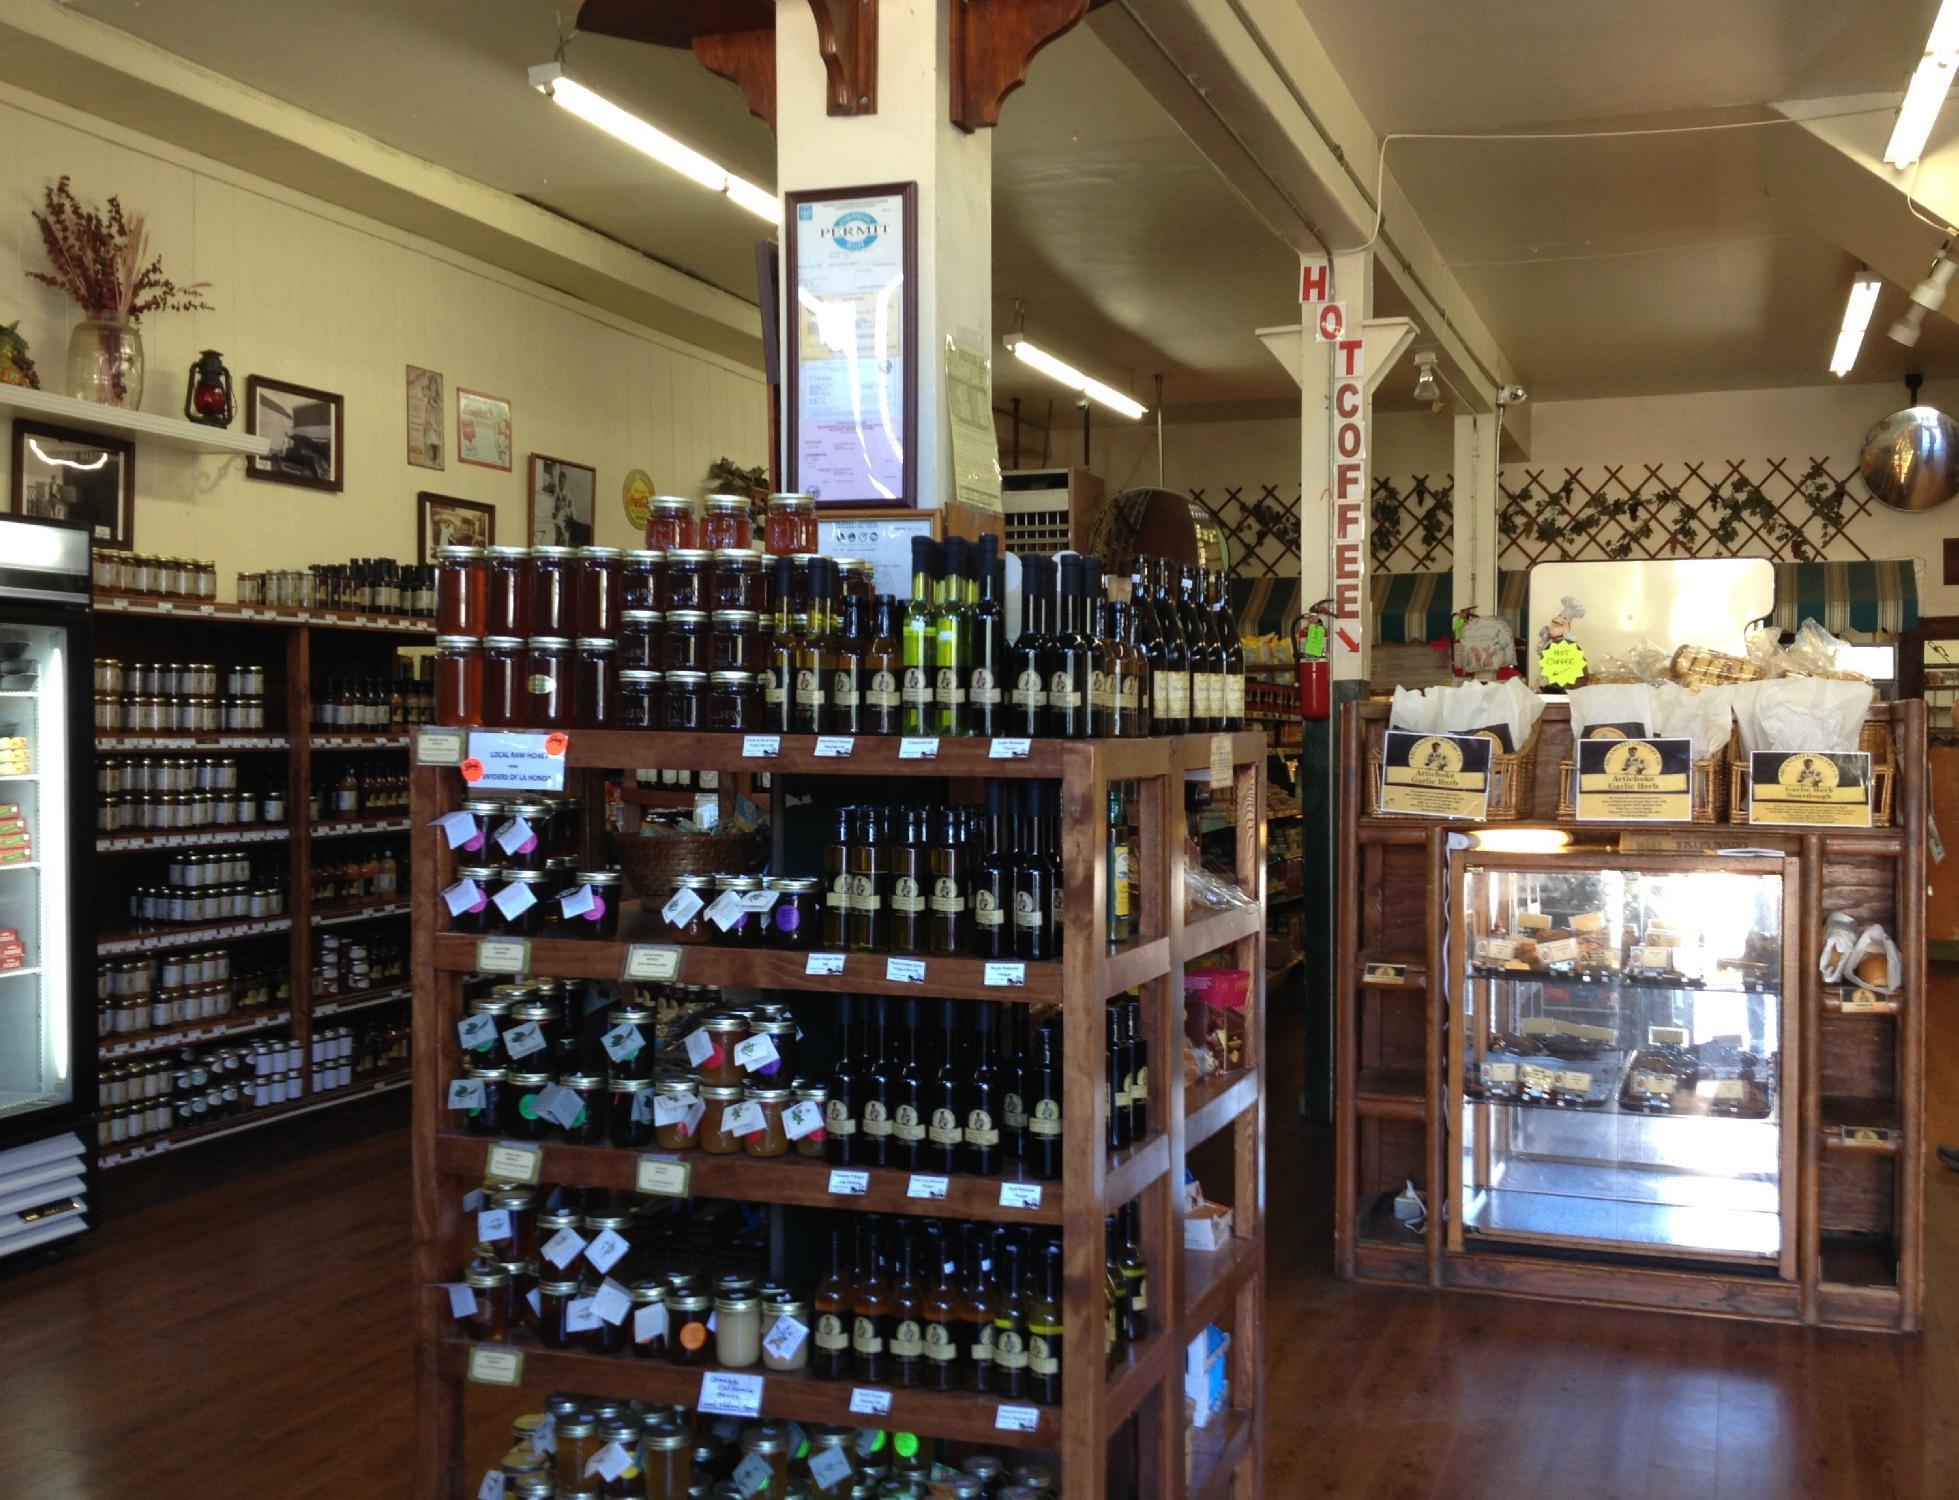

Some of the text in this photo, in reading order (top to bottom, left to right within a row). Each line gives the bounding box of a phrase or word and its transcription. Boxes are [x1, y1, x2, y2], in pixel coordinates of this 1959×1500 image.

[821, 224, 889, 239] PERMIT
[1302, 265, 1363, 619] HOT COFFEE
[490, 751, 509, 759] LOCAL
[510, 751, 526, 759] RAW
[1415, 770, 1454, 778] Artichoke
[1438, 778, 1458, 786] Herb
[1608, 782, 1659, 790] Garlic Herb
